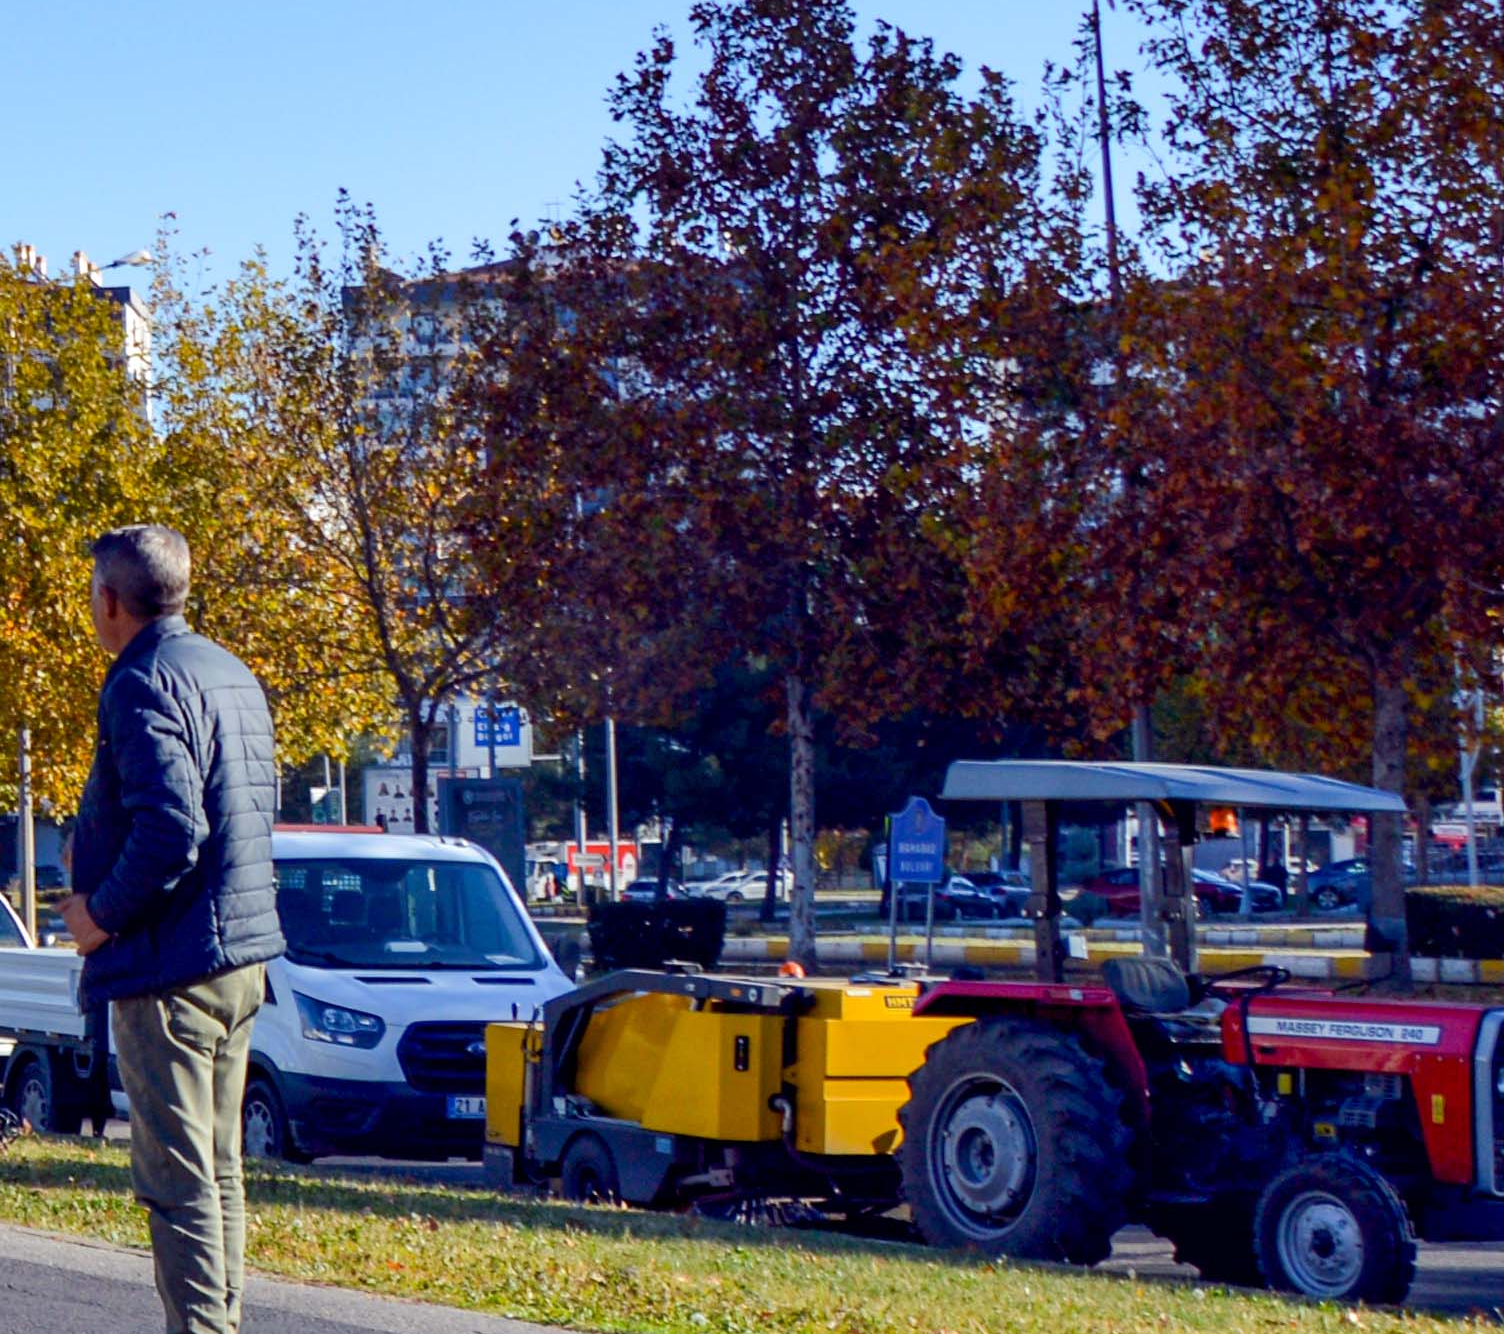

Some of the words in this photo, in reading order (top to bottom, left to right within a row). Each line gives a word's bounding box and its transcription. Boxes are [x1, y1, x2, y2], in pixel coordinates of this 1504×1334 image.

[1276, 1021, 1325, 1035] MASSEY
[1329, 1025, 1394, 1039] FERGUSON
[1401, 1028, 1424, 1040] 240
